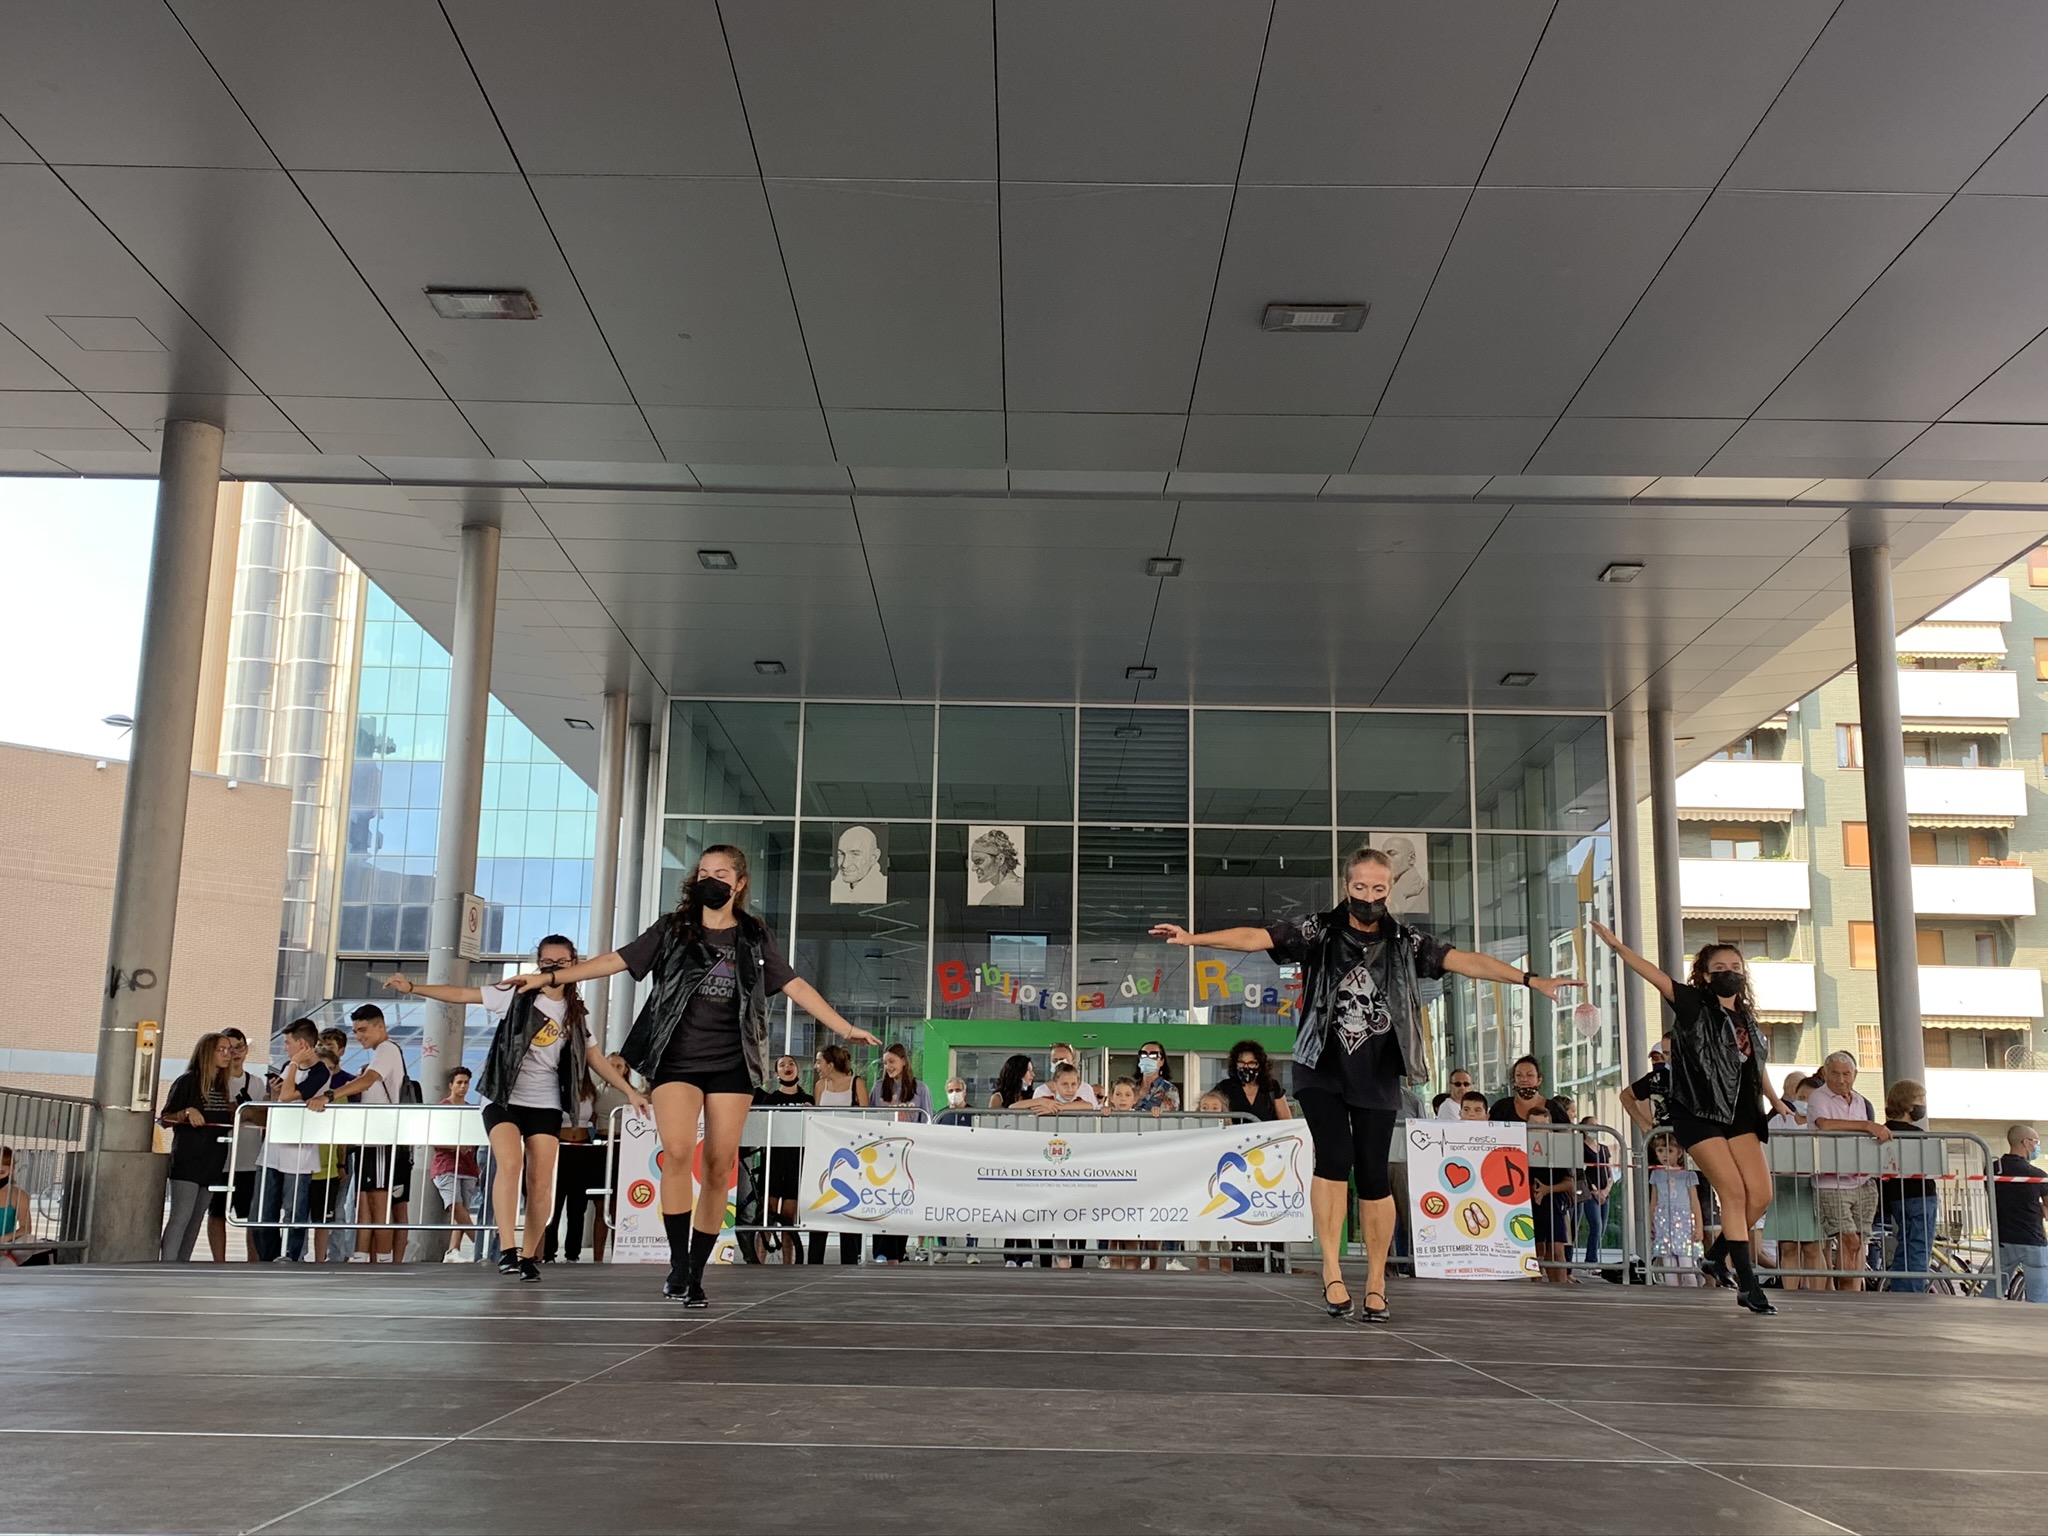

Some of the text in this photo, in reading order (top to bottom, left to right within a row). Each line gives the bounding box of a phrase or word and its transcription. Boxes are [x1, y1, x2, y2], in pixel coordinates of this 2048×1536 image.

[936, 960, 1106, 1013] Biblioteca
[1120, 969, 1163, 998] dei
[924, 1206, 1188, 1223] EUROPEAN CITY OF SPORT 2022
[1438, 1244, 1473, 1253] SETTEMBRE
